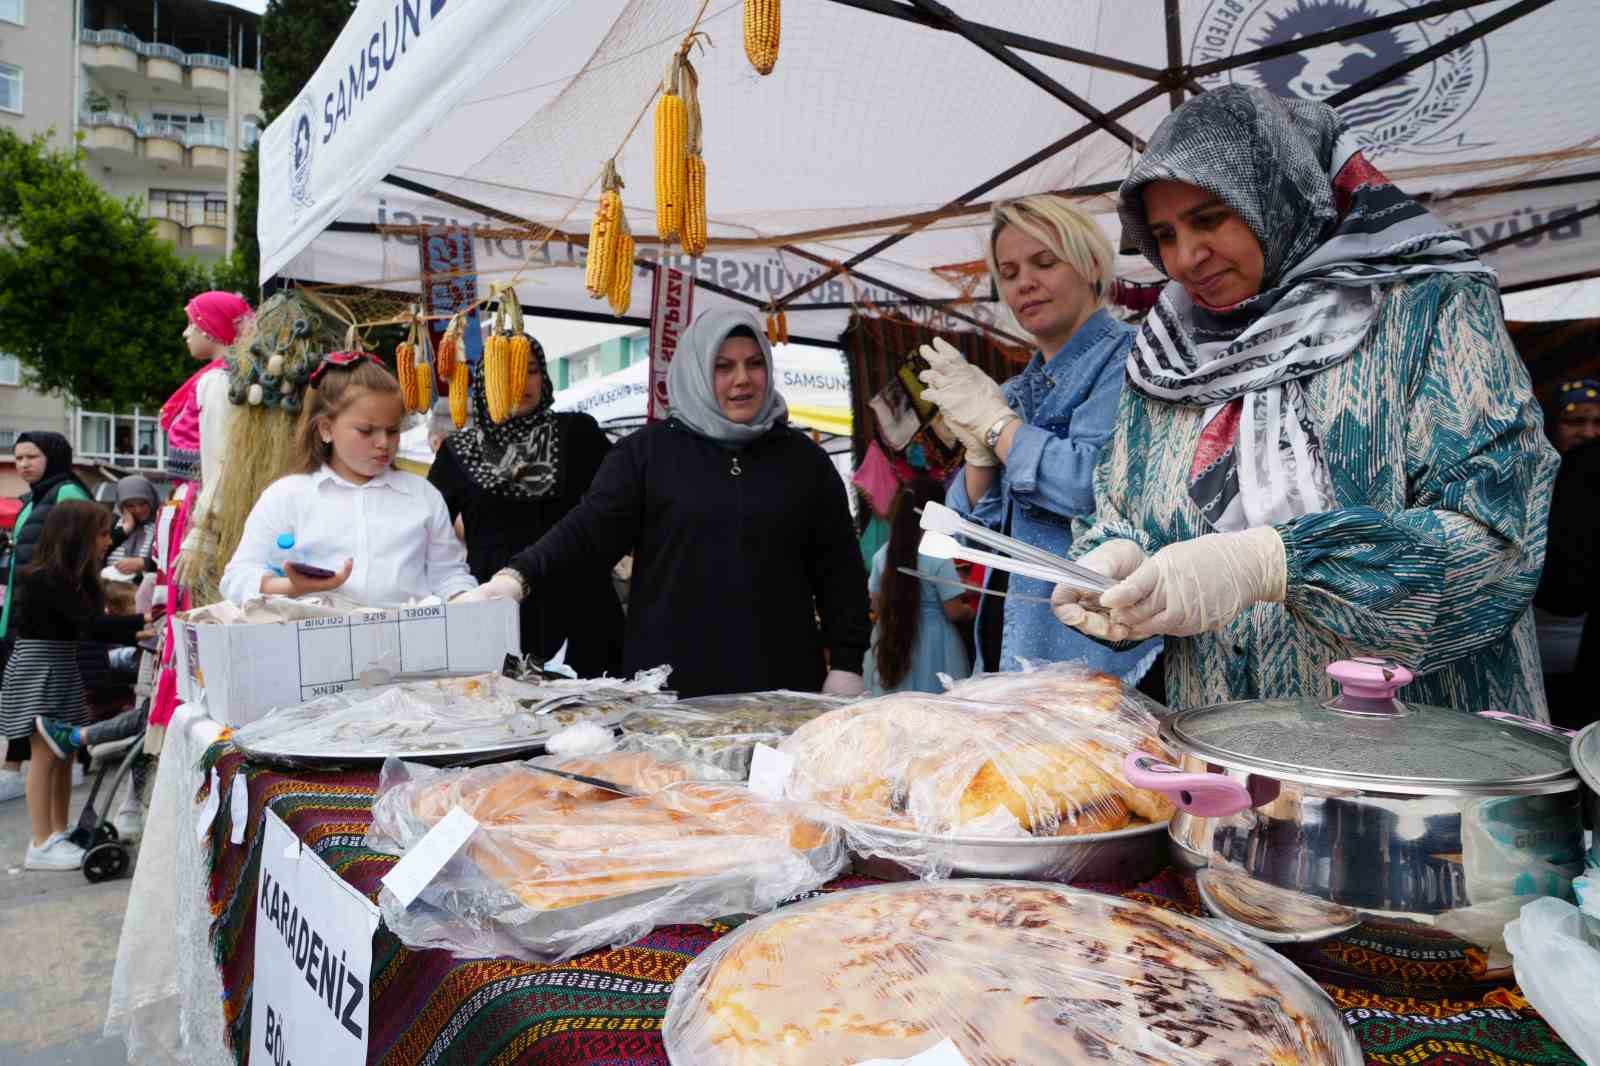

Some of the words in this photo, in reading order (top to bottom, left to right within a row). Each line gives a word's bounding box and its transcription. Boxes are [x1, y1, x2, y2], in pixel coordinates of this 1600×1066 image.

[323, 0, 420, 144] SAMSUN
[784, 371, 846, 392] SAMSUN
[405, 607, 440, 617] MODEL
[312, 683, 344, 696] RENK
[260, 867, 364, 1040] KARADENİZ
